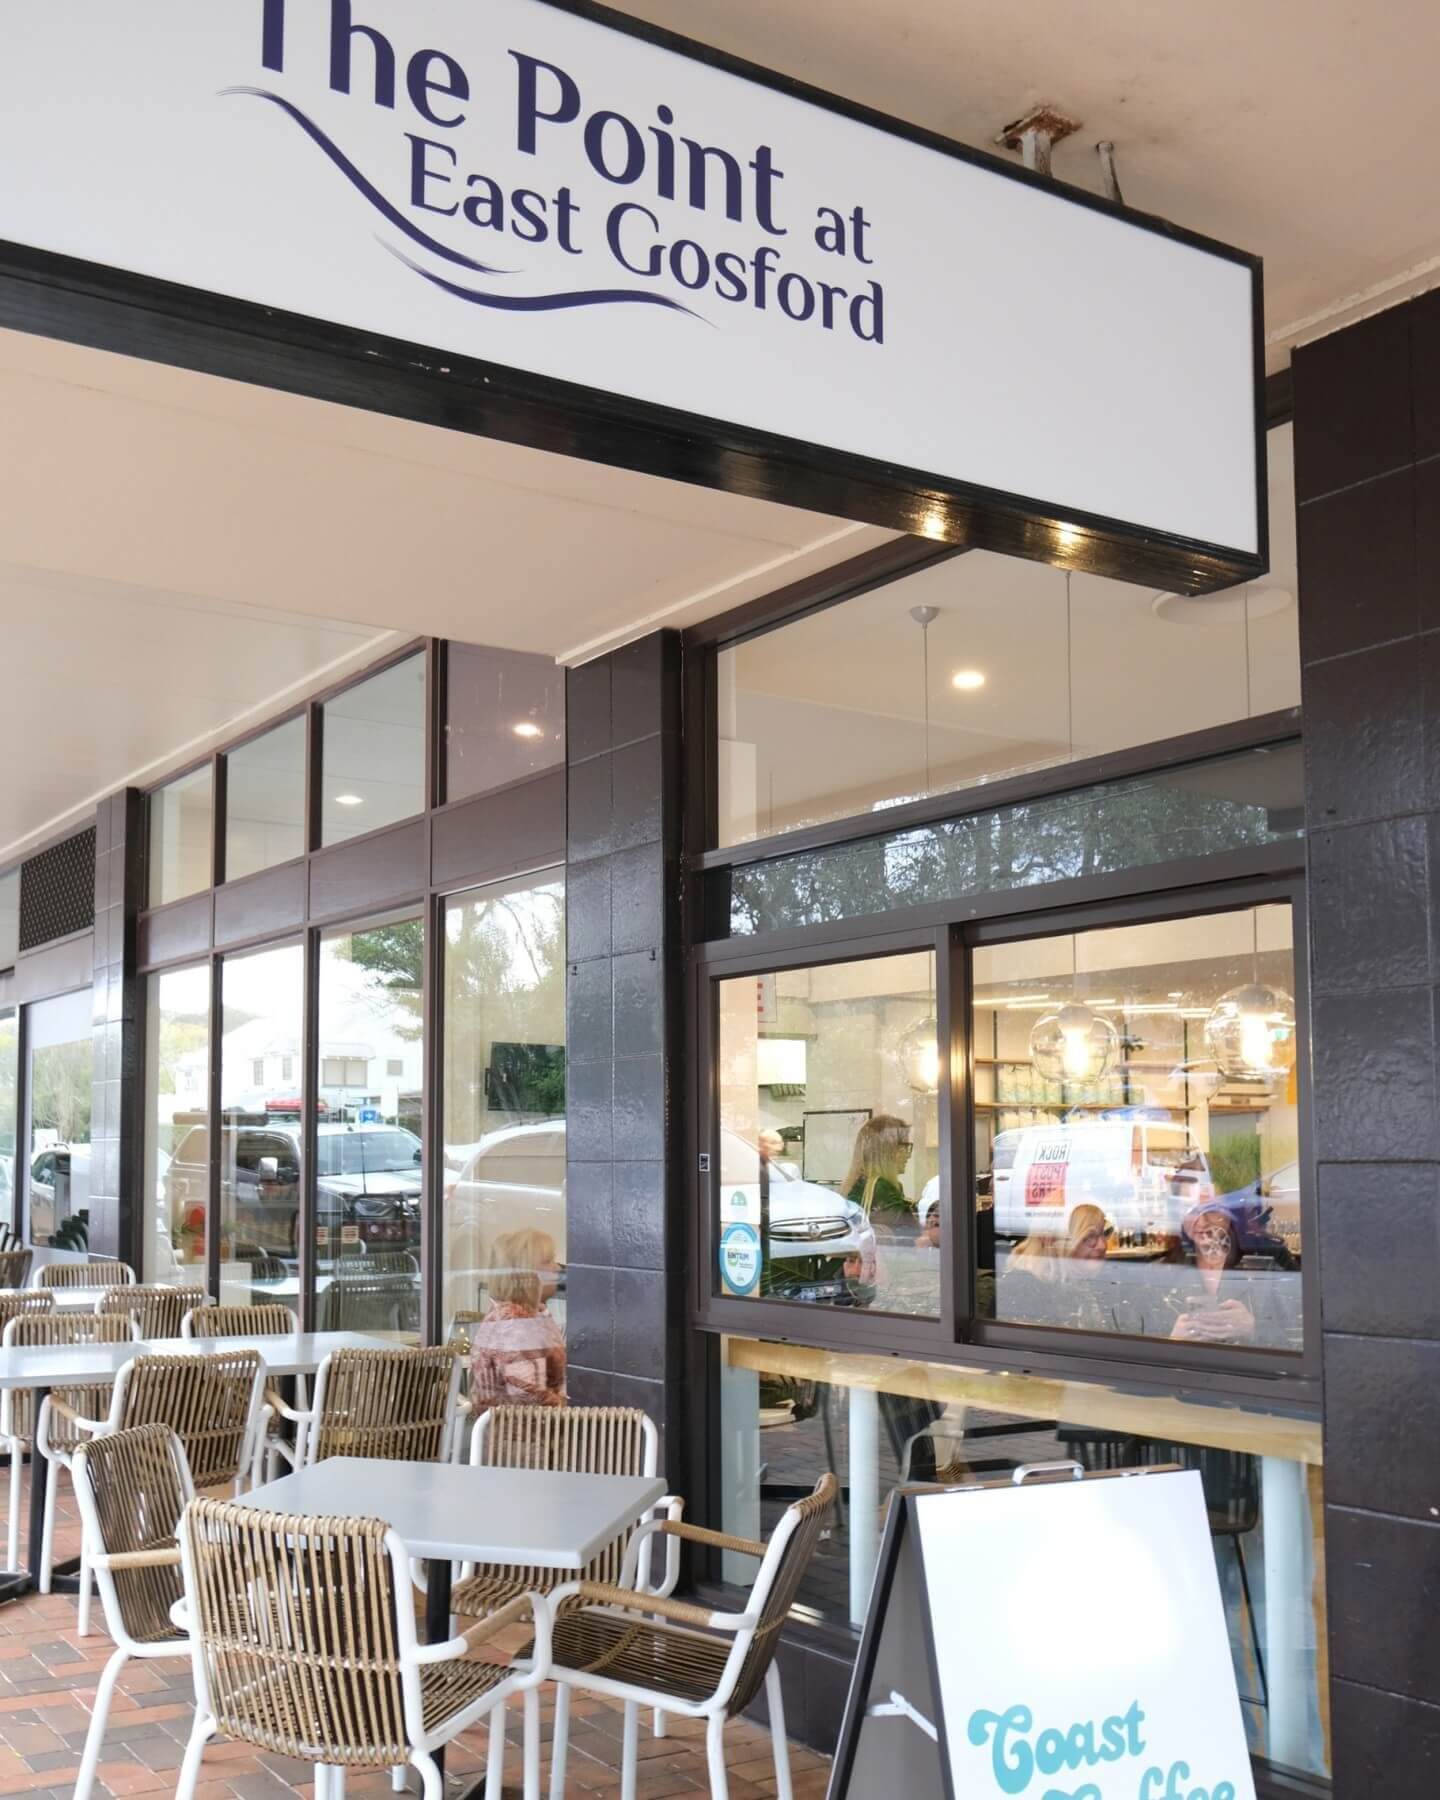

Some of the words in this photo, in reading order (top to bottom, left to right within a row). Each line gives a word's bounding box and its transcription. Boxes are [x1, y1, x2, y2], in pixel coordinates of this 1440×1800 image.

[404, 132, 583, 254] East
[606, 202, 884, 345] Gosford
[508, 50, 787, 236] Point
[815, 206, 873, 264] at
[968, 1699, 1147, 1795] Coast
